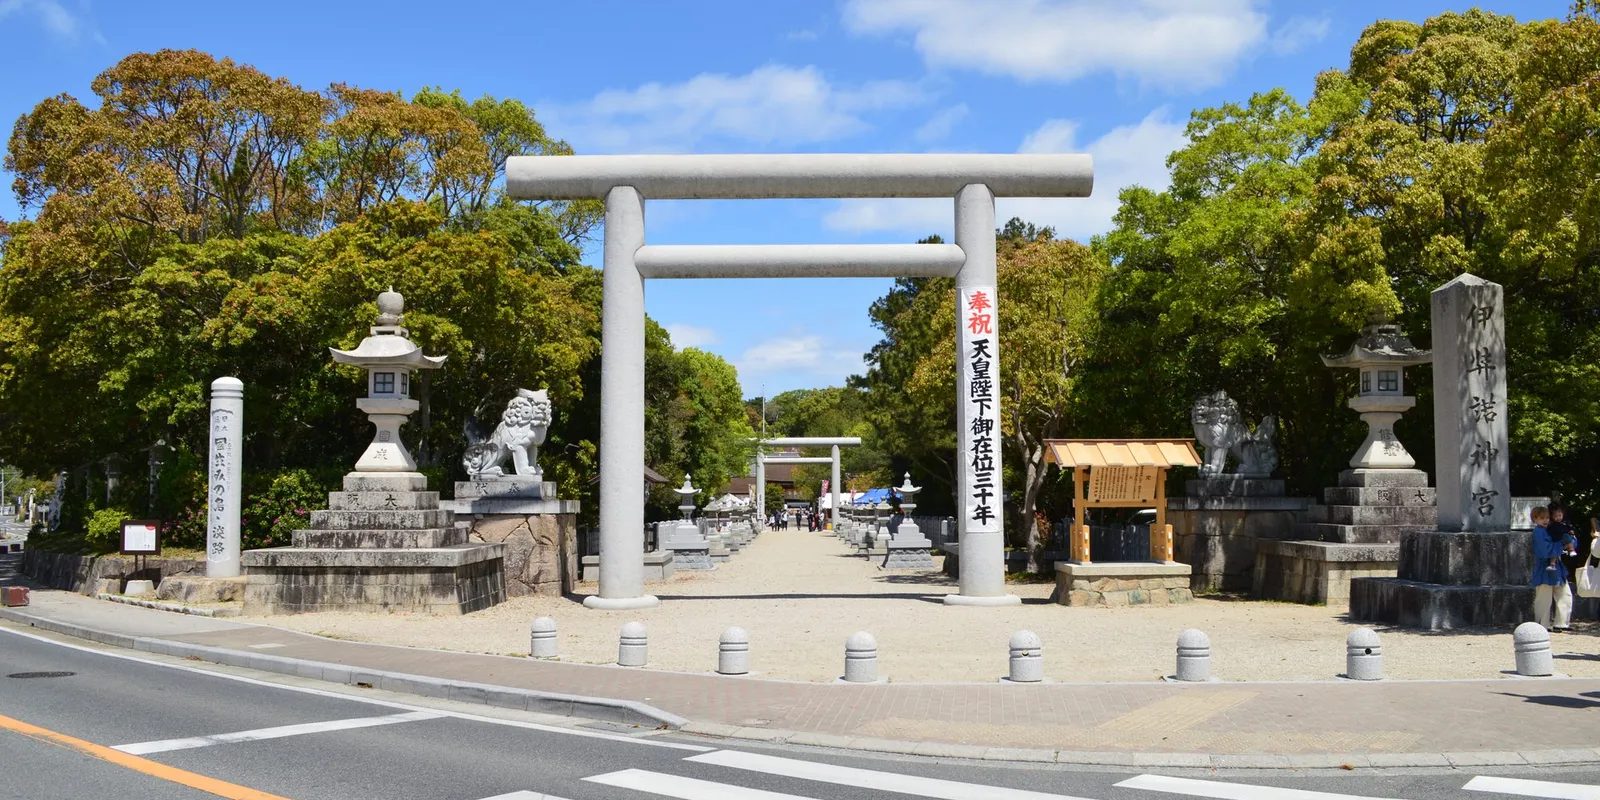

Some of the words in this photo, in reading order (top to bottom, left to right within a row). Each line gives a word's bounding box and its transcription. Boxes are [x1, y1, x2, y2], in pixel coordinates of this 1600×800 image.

[968, 291, 992, 335] 奉祝
[970, 338, 995, 526] 天皇陛下御在位三十年
